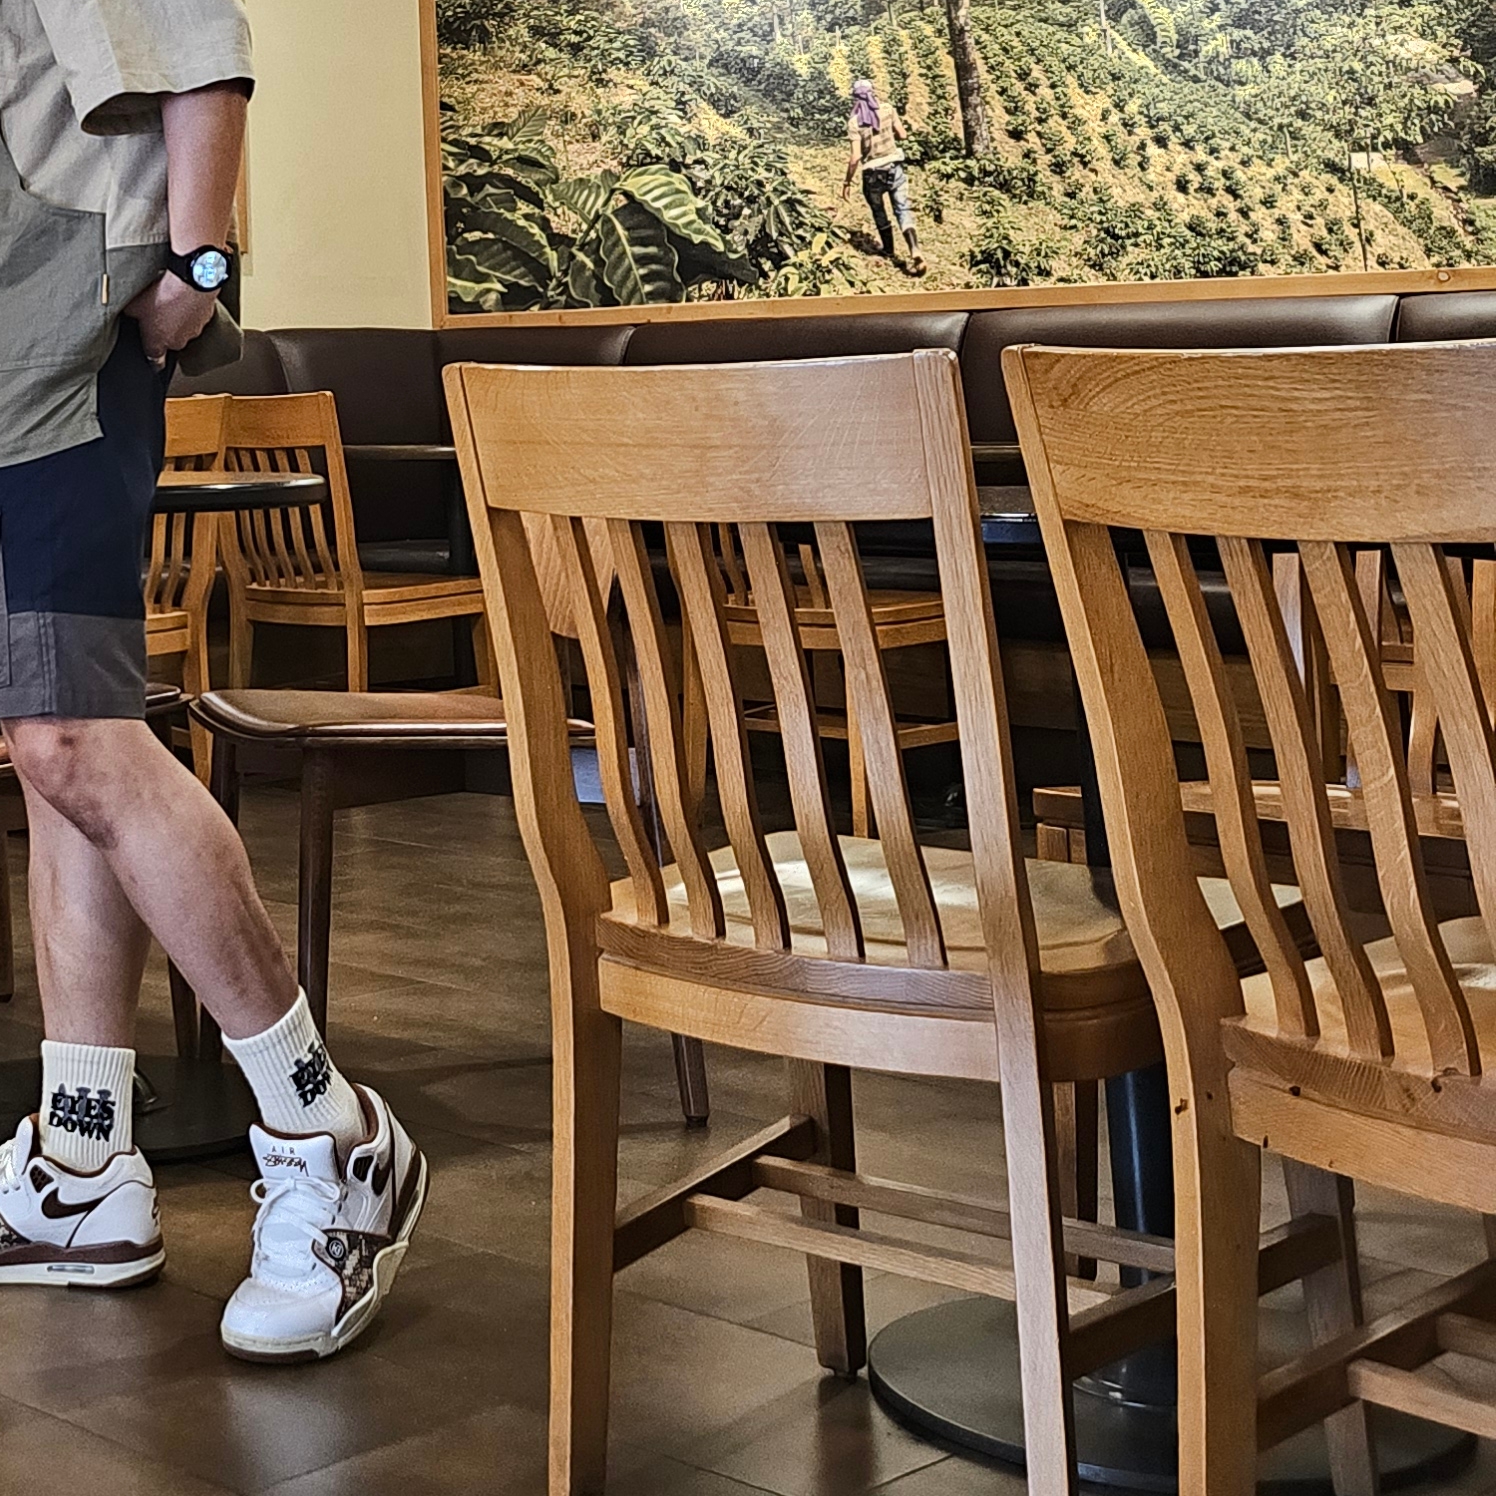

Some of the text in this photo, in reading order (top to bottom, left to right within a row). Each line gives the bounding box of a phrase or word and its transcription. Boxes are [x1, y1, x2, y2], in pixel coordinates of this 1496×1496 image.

[51, 1092, 116, 1120] EYES
[48, 1110, 114, 1142] DOWN
[271, 1145, 296, 1155] AIR
